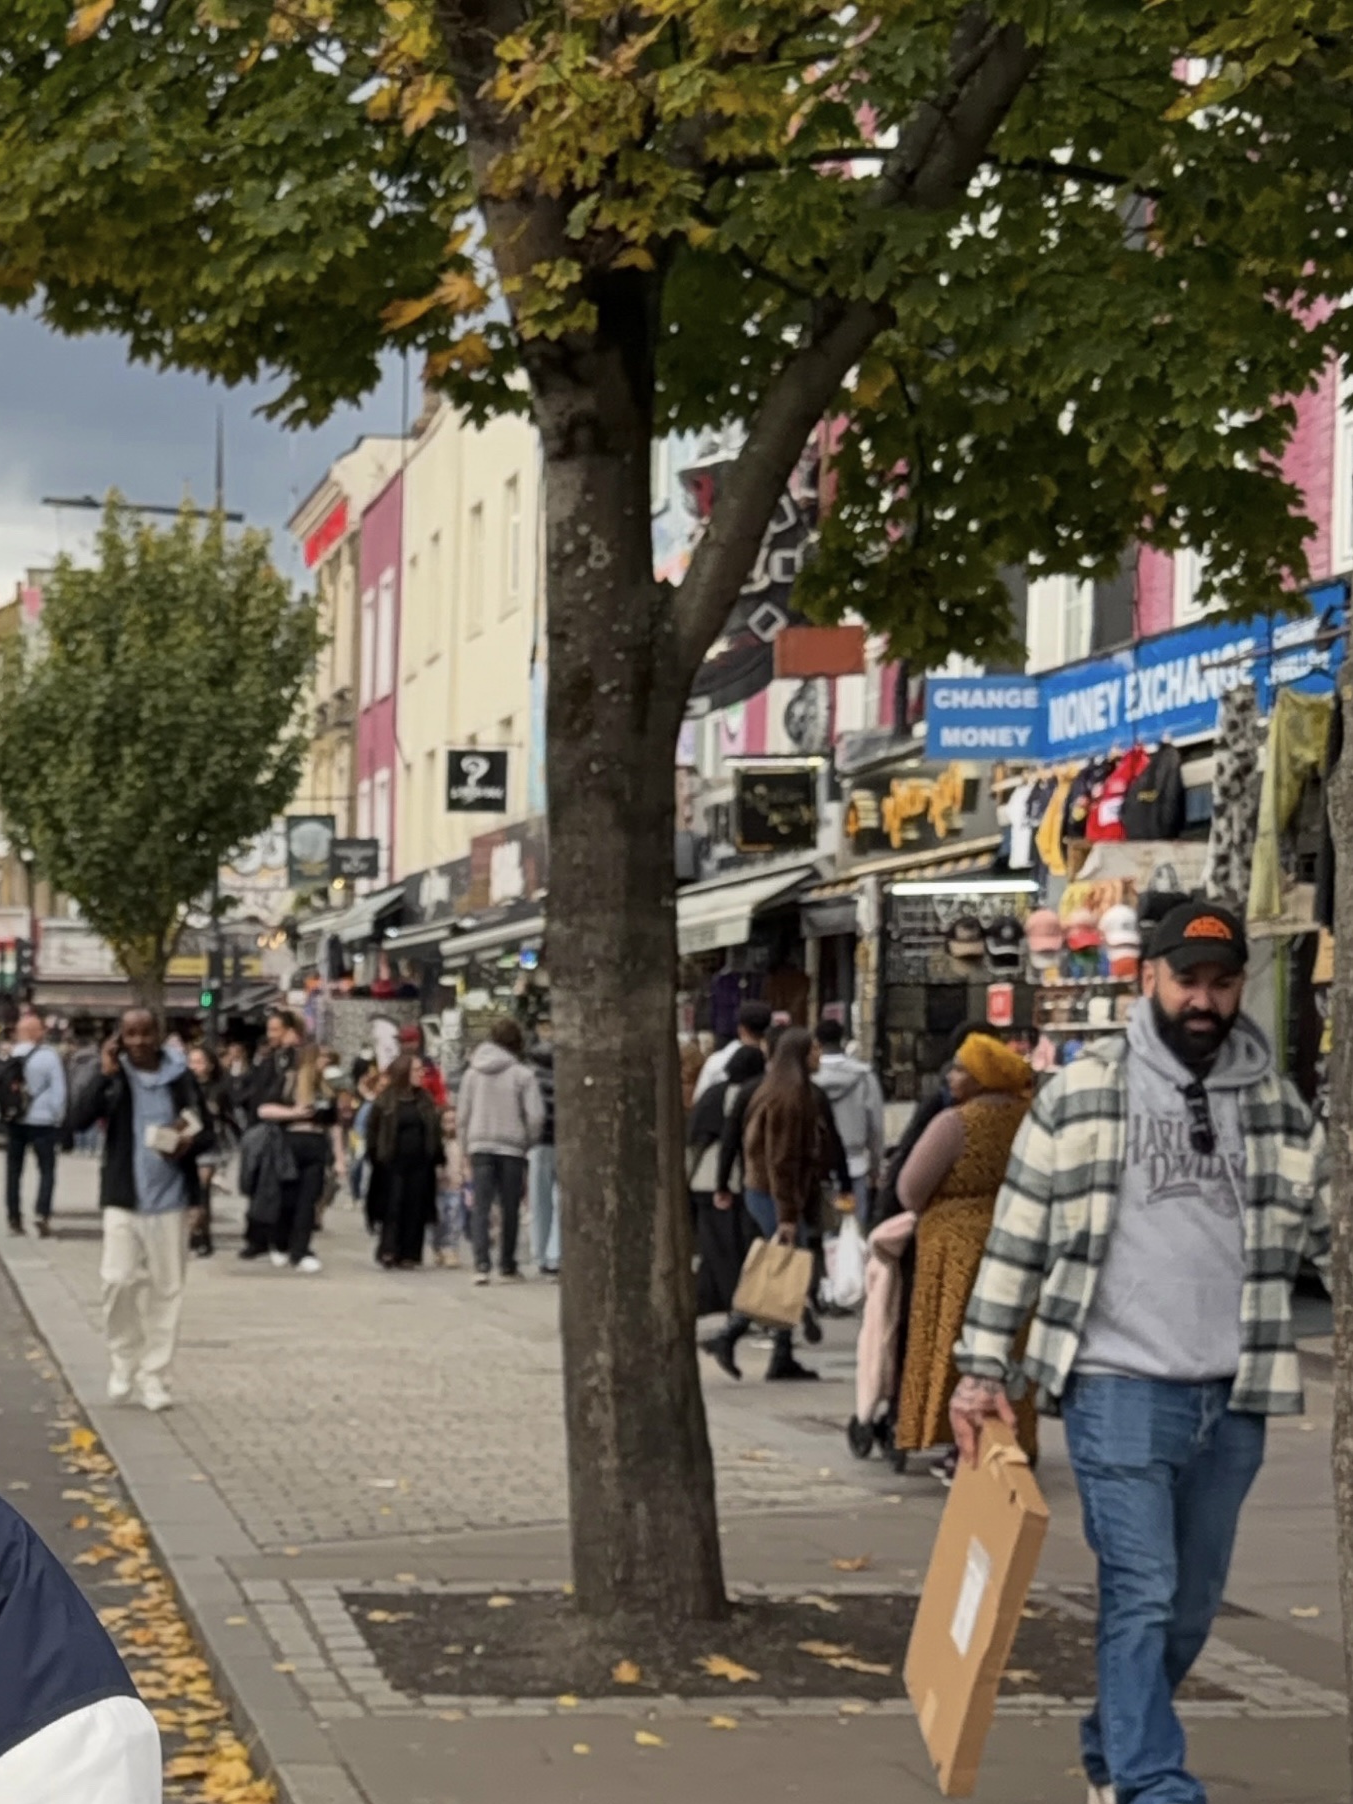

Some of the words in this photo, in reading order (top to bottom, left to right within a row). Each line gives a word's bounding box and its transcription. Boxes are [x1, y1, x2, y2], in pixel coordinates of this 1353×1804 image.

[933, 687, 1039, 709] CHANGE
[1049, 678, 1121, 744] MONEY
[1125, 637, 1257, 724] EXCHANGE
[939, 725, 1033, 748] MONEY
